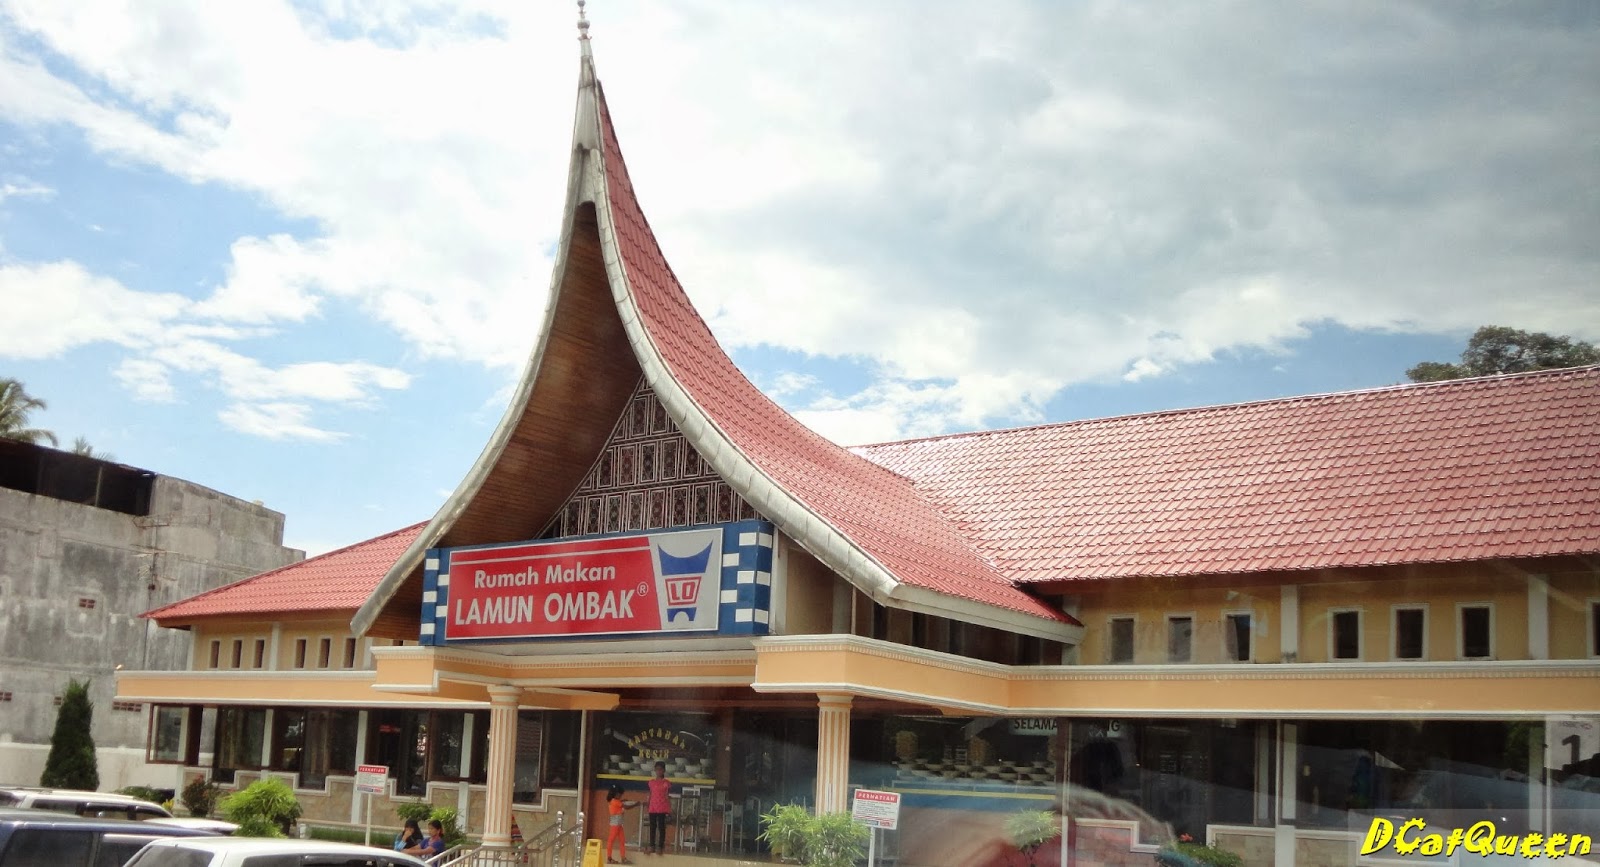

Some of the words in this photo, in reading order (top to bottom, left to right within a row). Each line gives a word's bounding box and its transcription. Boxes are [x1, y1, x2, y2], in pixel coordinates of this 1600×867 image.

[474, 568, 540, 589] Rumah
[545, 562, 616, 583] Makan
[671, 582, 697, 600] LO
[455, 596, 534, 626] LAMUN
[1013, 718, 1058, 730] SELAMA
